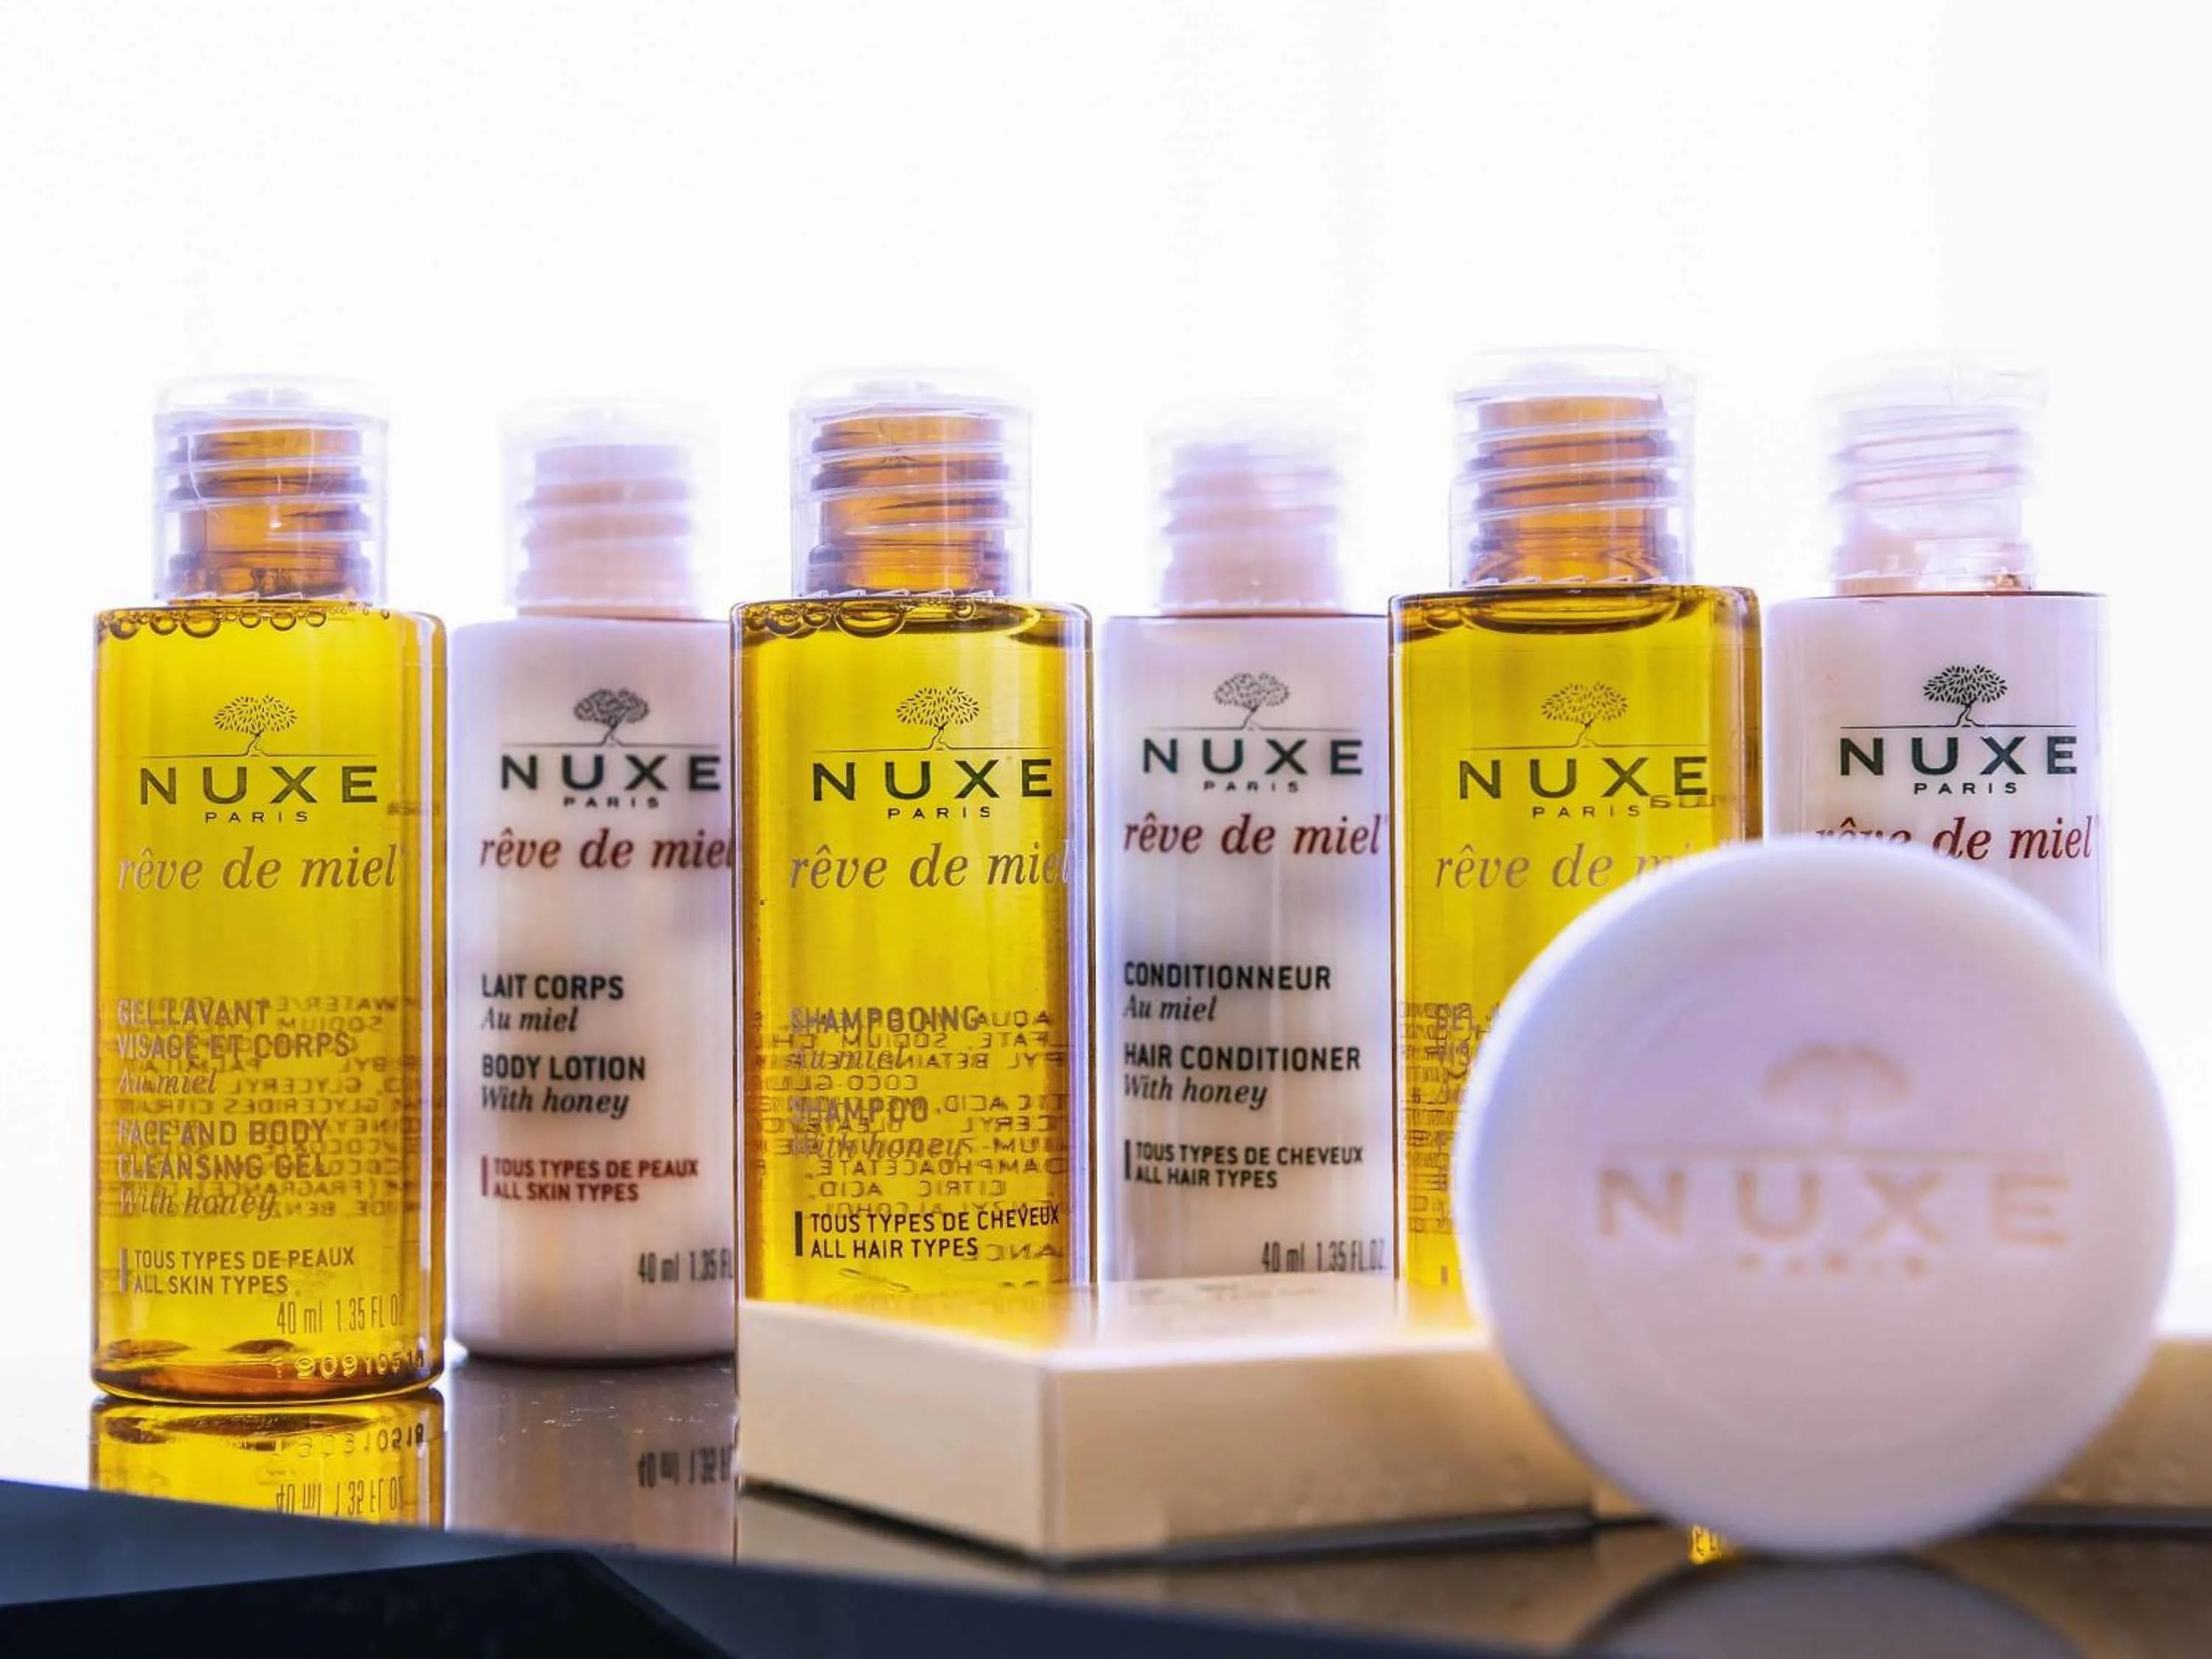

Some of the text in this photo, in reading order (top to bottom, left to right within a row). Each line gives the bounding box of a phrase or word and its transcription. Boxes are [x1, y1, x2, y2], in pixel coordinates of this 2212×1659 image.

[1144, 738, 1363, 775] NUXE
[1840, 737, 2077, 776] NUXE
[140, 766, 378, 804] NUXE
[501, 754, 721, 791] NUXE
[813, 759, 1052, 801] NUXE
[1459, 756, 1708, 799] NUXE
[1203, 781, 1300, 793] PARIS
[1914, 782, 2017, 794] PARIS
[563, 796, 660, 809] PARIS
[888, 806, 990, 819] PARIS
[1532, 804, 1641, 819] PARIS
[205, 812, 307, 824] PARIS
[1124, 812, 1382, 855] rêve de miel
[1933, 816, 1992, 860] de
[2008, 815, 2093, 859] miel
[480, 827, 562, 869] rêve
[579, 827, 635, 869] de
[119, 844, 397, 890] rêve de miel
[790, 838, 1073, 889] rêve de miel
[1436, 844, 1530, 889] rêve
[1552, 842, 1613, 888] de
[481, 974, 625, 1001] LAIT CORPS
[1124, 961, 1331, 990] CONDITIONNEUR
[481, 1006, 579, 1032] Au miel
[790, 1006, 980, 1032] SHAMPOOING
[1124, 995, 1217, 1021] Au miel
[117, 1032, 349, 1060] VISAGE ET CORPS
[1124, 1043, 1360, 1071] HAIR CONDITIONER
[157, 1068, 217, 1094] miel
[481, 1054, 646, 1081] BODY LOTION
[481, 1086, 630, 1120] With honey
[1124, 1074, 1267, 1110] With honey
[790, 1096, 928, 1124] SHAMPOO
[117, 1119, 170, 1146] FACE
[180, 1119, 237, 1146] AND
[248, 1119, 328, 1146] BODY
[119, 1153, 263, 1180] CLEANSING
[274, 1152, 330, 1180] GEL
[1136, 1141, 1363, 1166] TOUS TYPES DE CHEVEUX
[494, 1158, 699, 1179] TOUS TYPES DE PEAUX
[1136, 1166, 1278, 1189] ALL HAIR TYPES
[184, 1186, 277, 1221] honey
[494, 1182, 639, 1202] ALL SKIN TYPES
[812, 1213, 860, 1234] TOUS
[867, 1213, 934, 1234] TYPES
[943, 1211, 970, 1231] DE
[978, 1205, 1060, 1231] CHEVEUX
[1596, 1169, 2073, 1248] NUXE
[134, 1246, 355, 1270] TOUS TYPES DE PEAUX
[812, 1239, 846, 1259] ALL
[853, 1239, 903, 1259] HAIR
[913, 1237, 978, 1259] TYPES
[1262, 1240, 1281, 1273] 40
[1287, 1242, 1304, 1273] ml
[638, 1252, 656, 1284] 40
[134, 1275, 288, 1295] ALL SKIN TYPES
[277, 1301, 295, 1334] 40
[304, 1300, 322, 1333] ml
